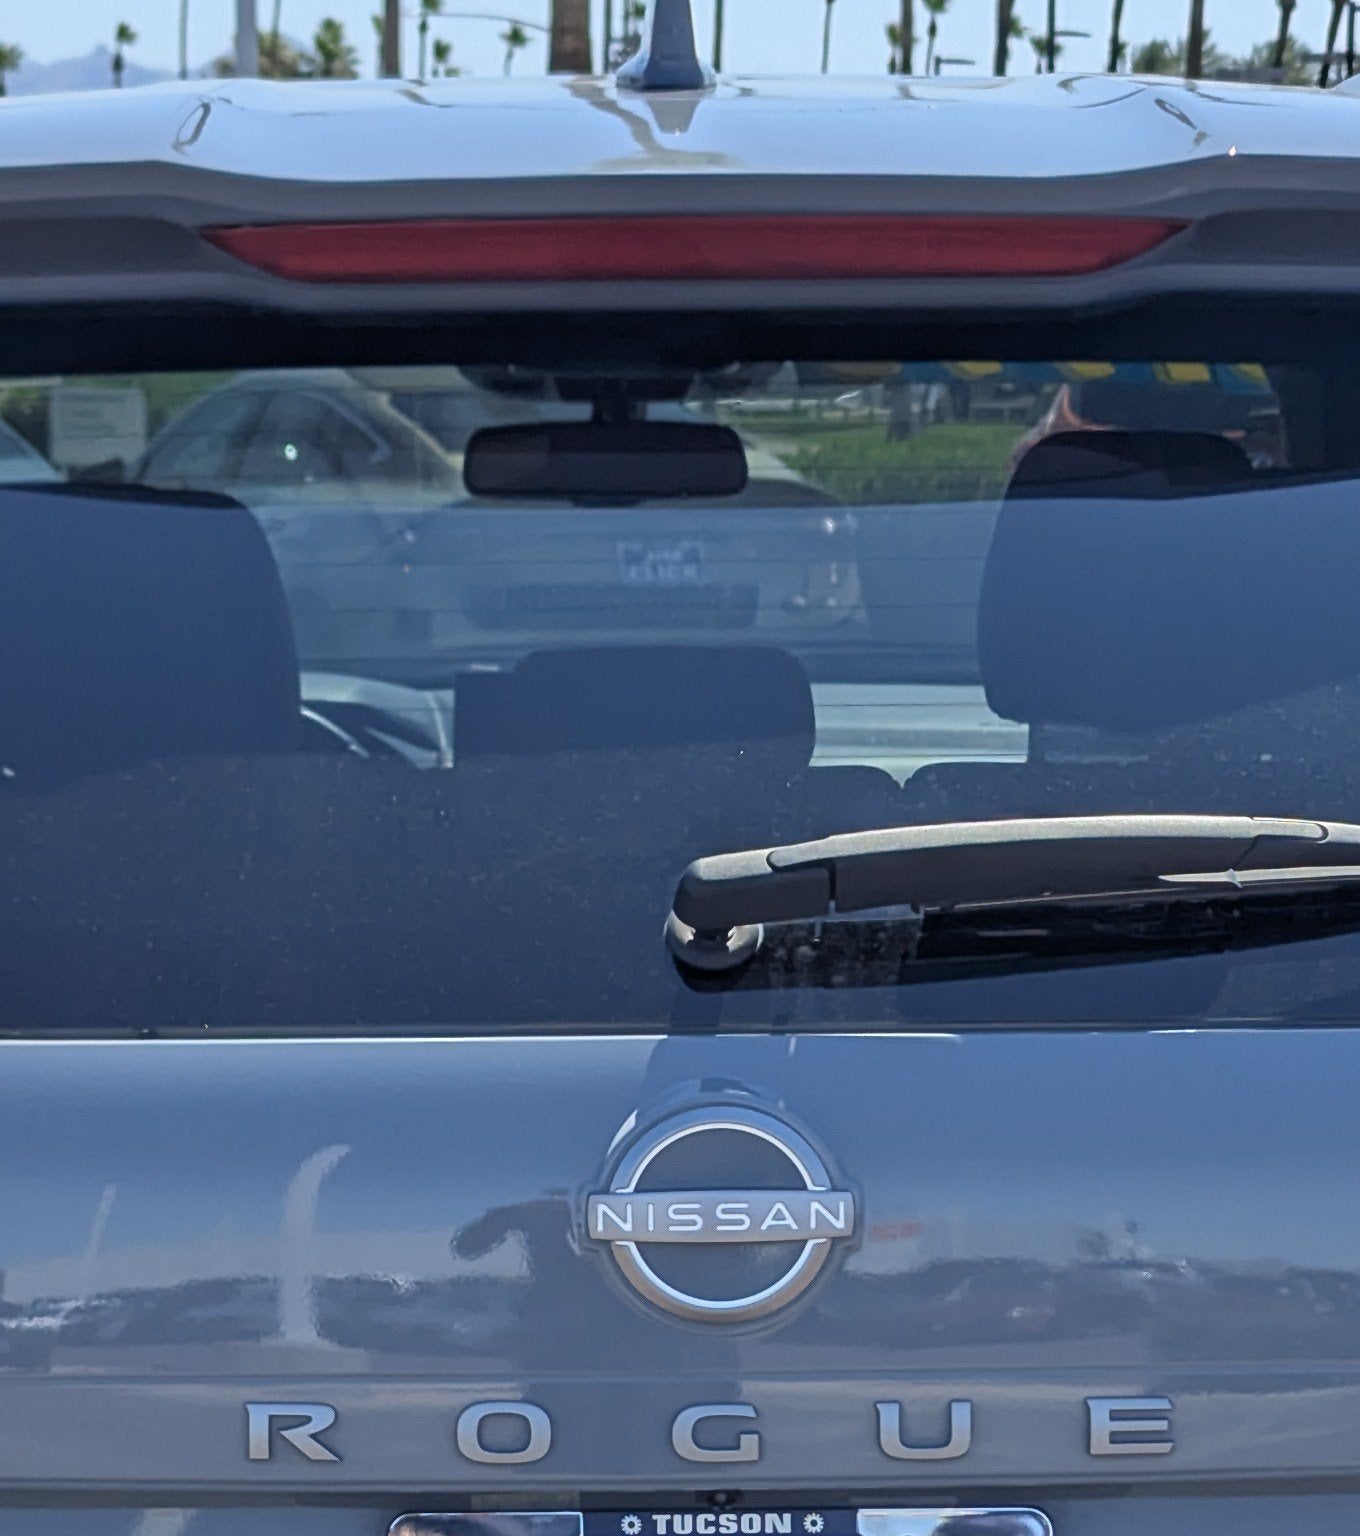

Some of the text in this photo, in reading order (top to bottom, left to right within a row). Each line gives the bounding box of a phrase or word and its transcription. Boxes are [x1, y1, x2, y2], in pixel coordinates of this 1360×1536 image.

[596, 1200, 845, 1232] NISSAN
[245, 1398, 1174, 1464] ROGUE
[652, 1513, 792, 1535] TUCSON
